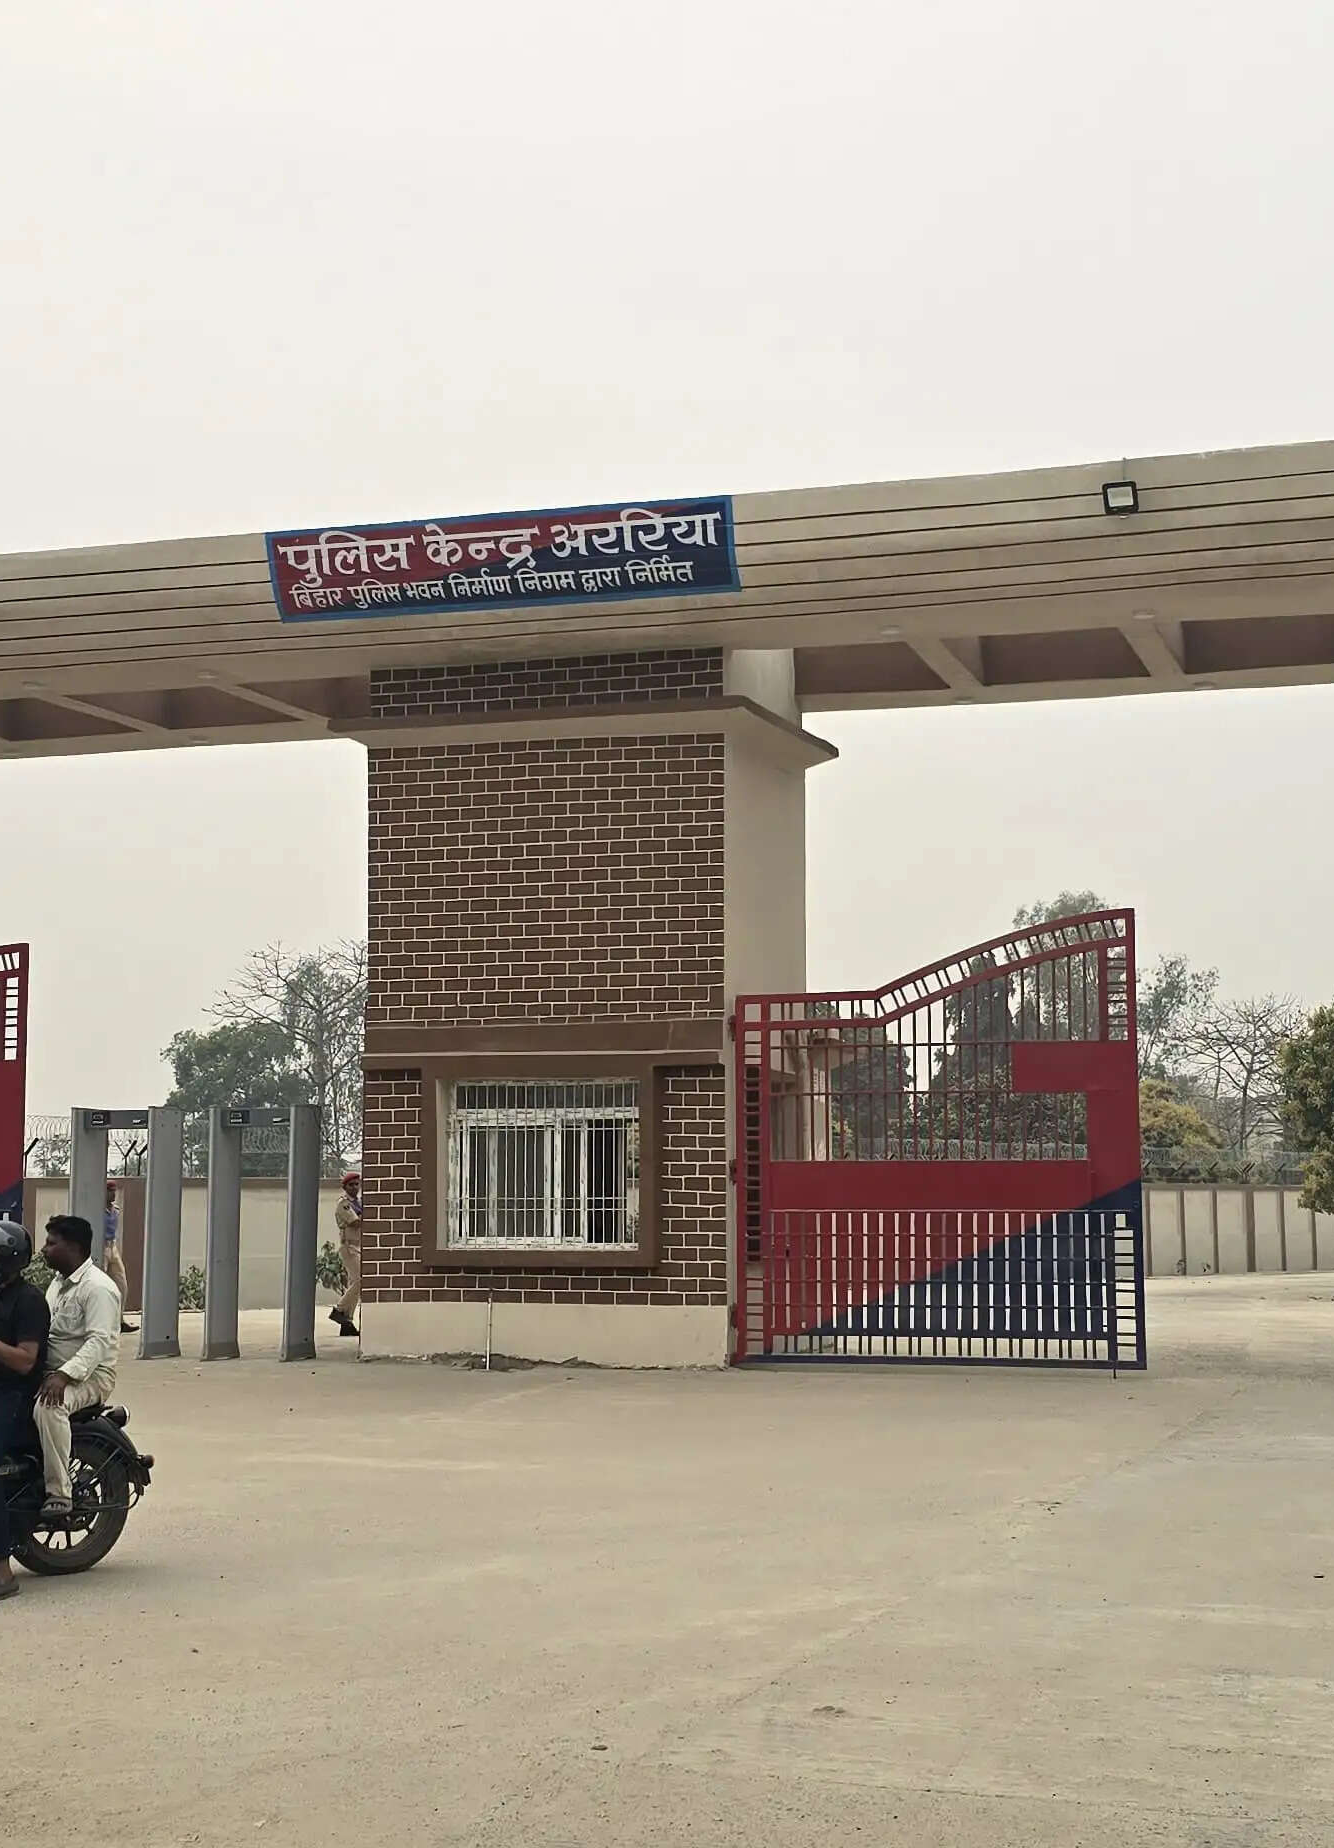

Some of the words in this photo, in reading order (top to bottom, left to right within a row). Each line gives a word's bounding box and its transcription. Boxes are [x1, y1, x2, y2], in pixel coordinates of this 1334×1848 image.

[278, 530, 415, 587] पुलिस
[422, 523, 541, 569] केन्द्र
[550, 508, 721, 558] अररिया
[289, 583, 348, 608] बिहार
[347, 579, 402, 609] पुलिस
[403, 580, 446, 600] भवन
[448, 568, 512, 599] निर्माण
[516, 568, 577, 593] निगम
[579, 567, 621, 593] द्वारा
[624, 555, 694, 585] निर्मित
